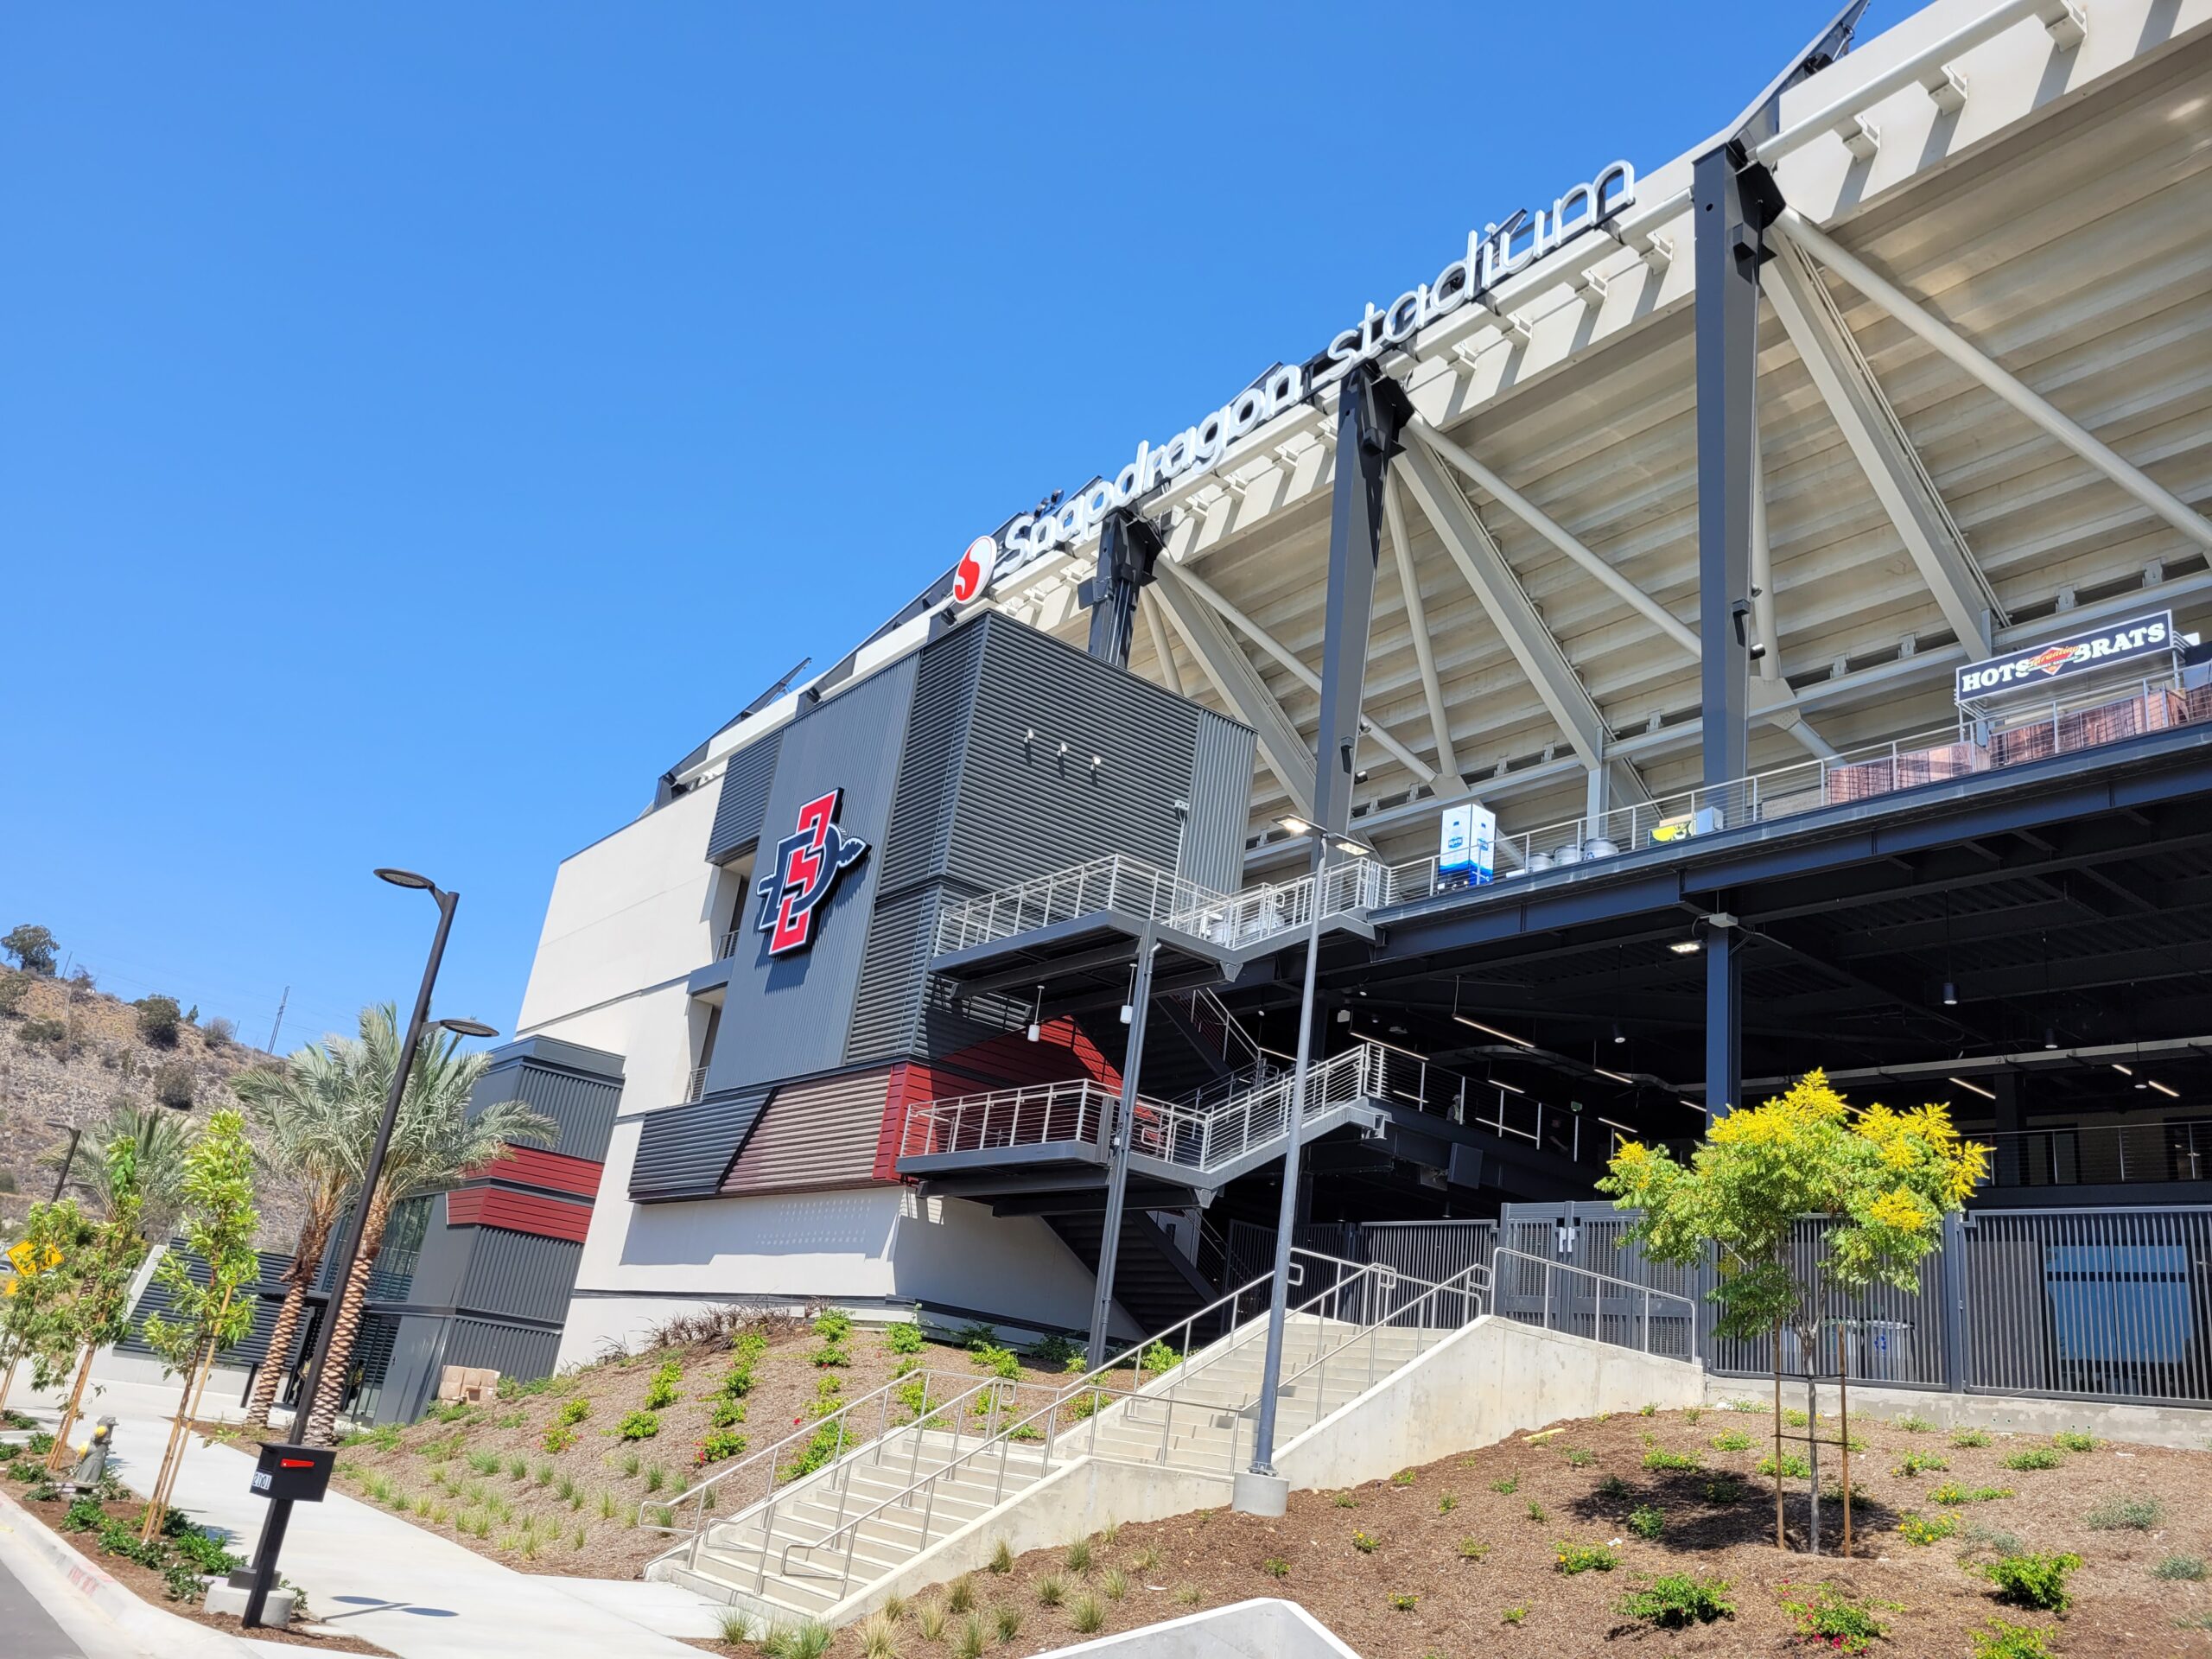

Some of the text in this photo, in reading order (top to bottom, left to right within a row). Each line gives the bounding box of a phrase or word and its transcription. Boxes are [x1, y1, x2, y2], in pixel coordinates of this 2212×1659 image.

[994, 159, 1635, 579] Snapdragon stadium
[1961, 658, 2031, 692] HOTS
[2073, 622, 2165, 664] BRATS
